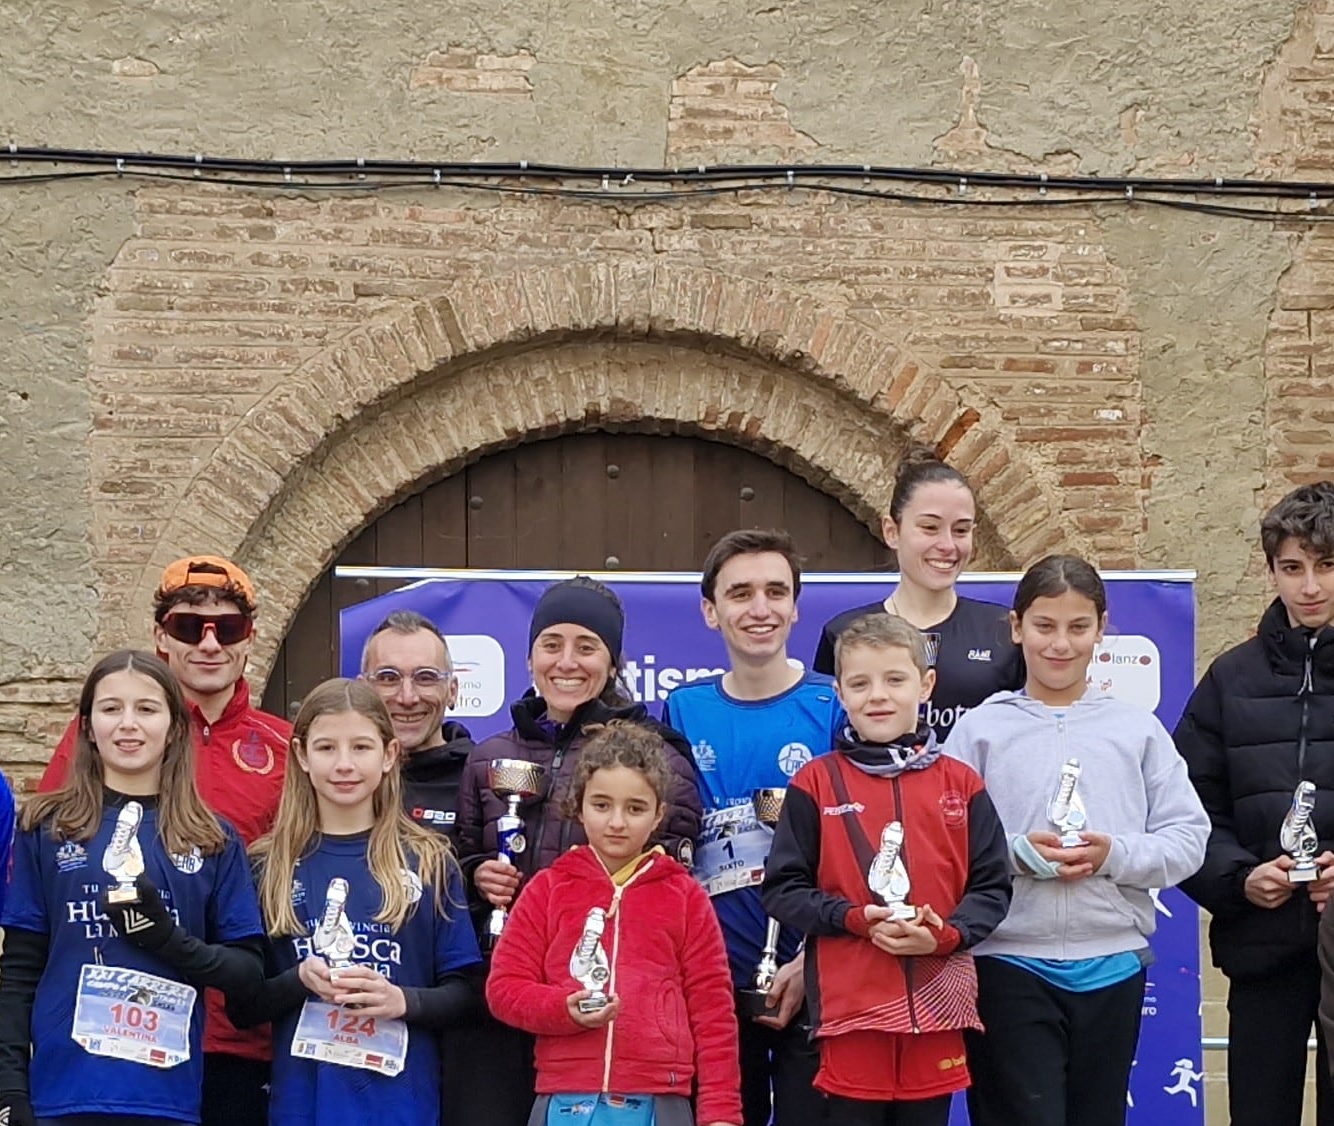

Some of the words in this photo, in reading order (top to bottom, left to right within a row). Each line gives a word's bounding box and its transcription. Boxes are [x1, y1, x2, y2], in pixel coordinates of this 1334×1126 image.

[721, 839, 735, 860] 1
[110, 1003, 160, 1033] 103
[325, 1008, 377, 1039] 124
[103, 1024, 158, 1045] VALENTINA
[333, 1033, 360, 1046] ALBA
